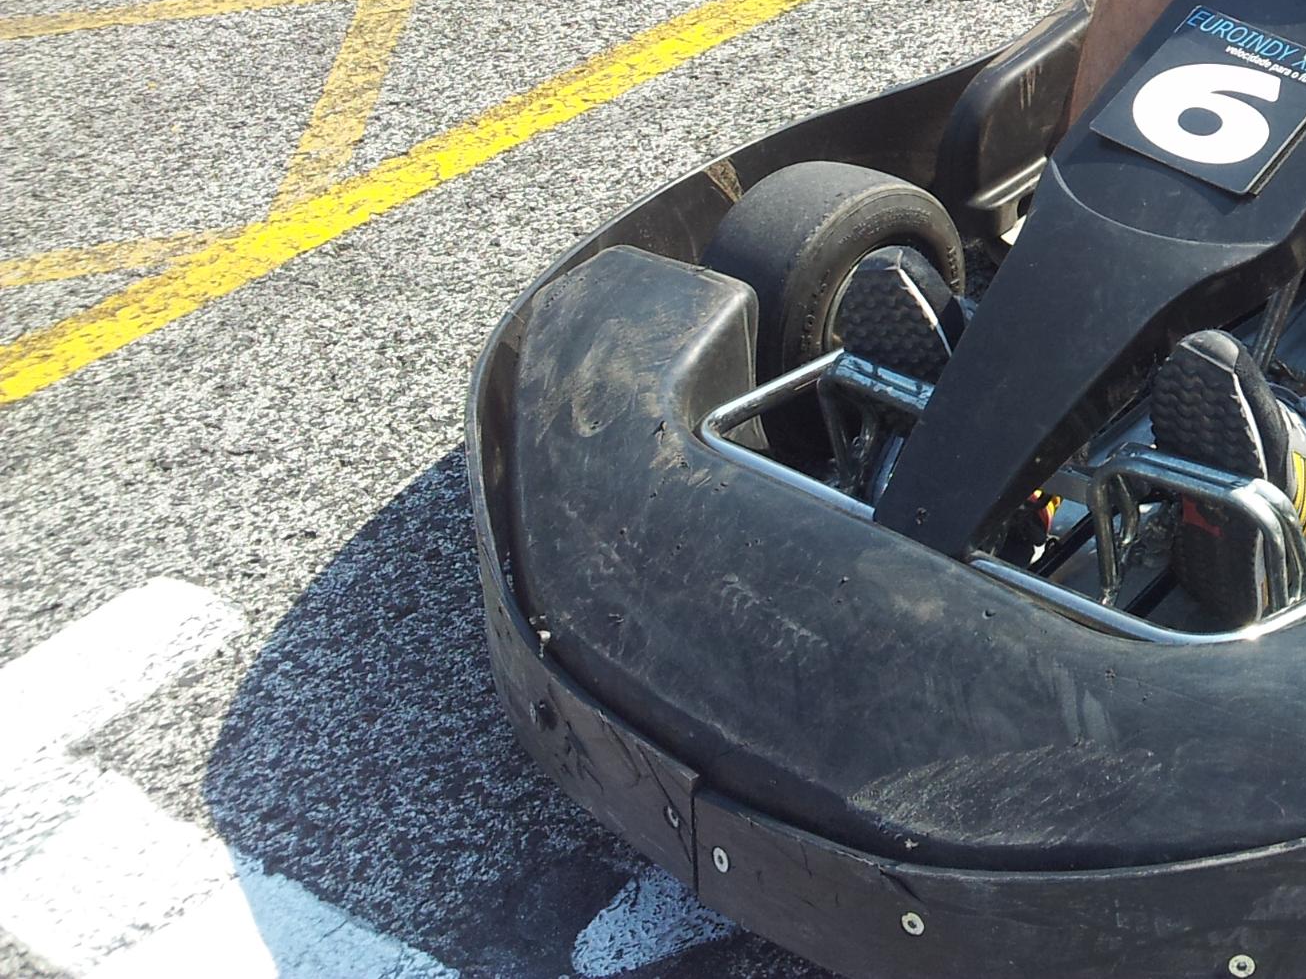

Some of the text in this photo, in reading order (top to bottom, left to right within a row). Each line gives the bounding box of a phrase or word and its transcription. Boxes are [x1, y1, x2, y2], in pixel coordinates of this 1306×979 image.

[1186, 10, 1300, 61] EUROINDY
[1225, 45, 1273, 68] velocidade
[1269, 63, 1293, 77] para
[1291, 71, 1300, 80] o
[1132, 63, 1282, 164] 6
